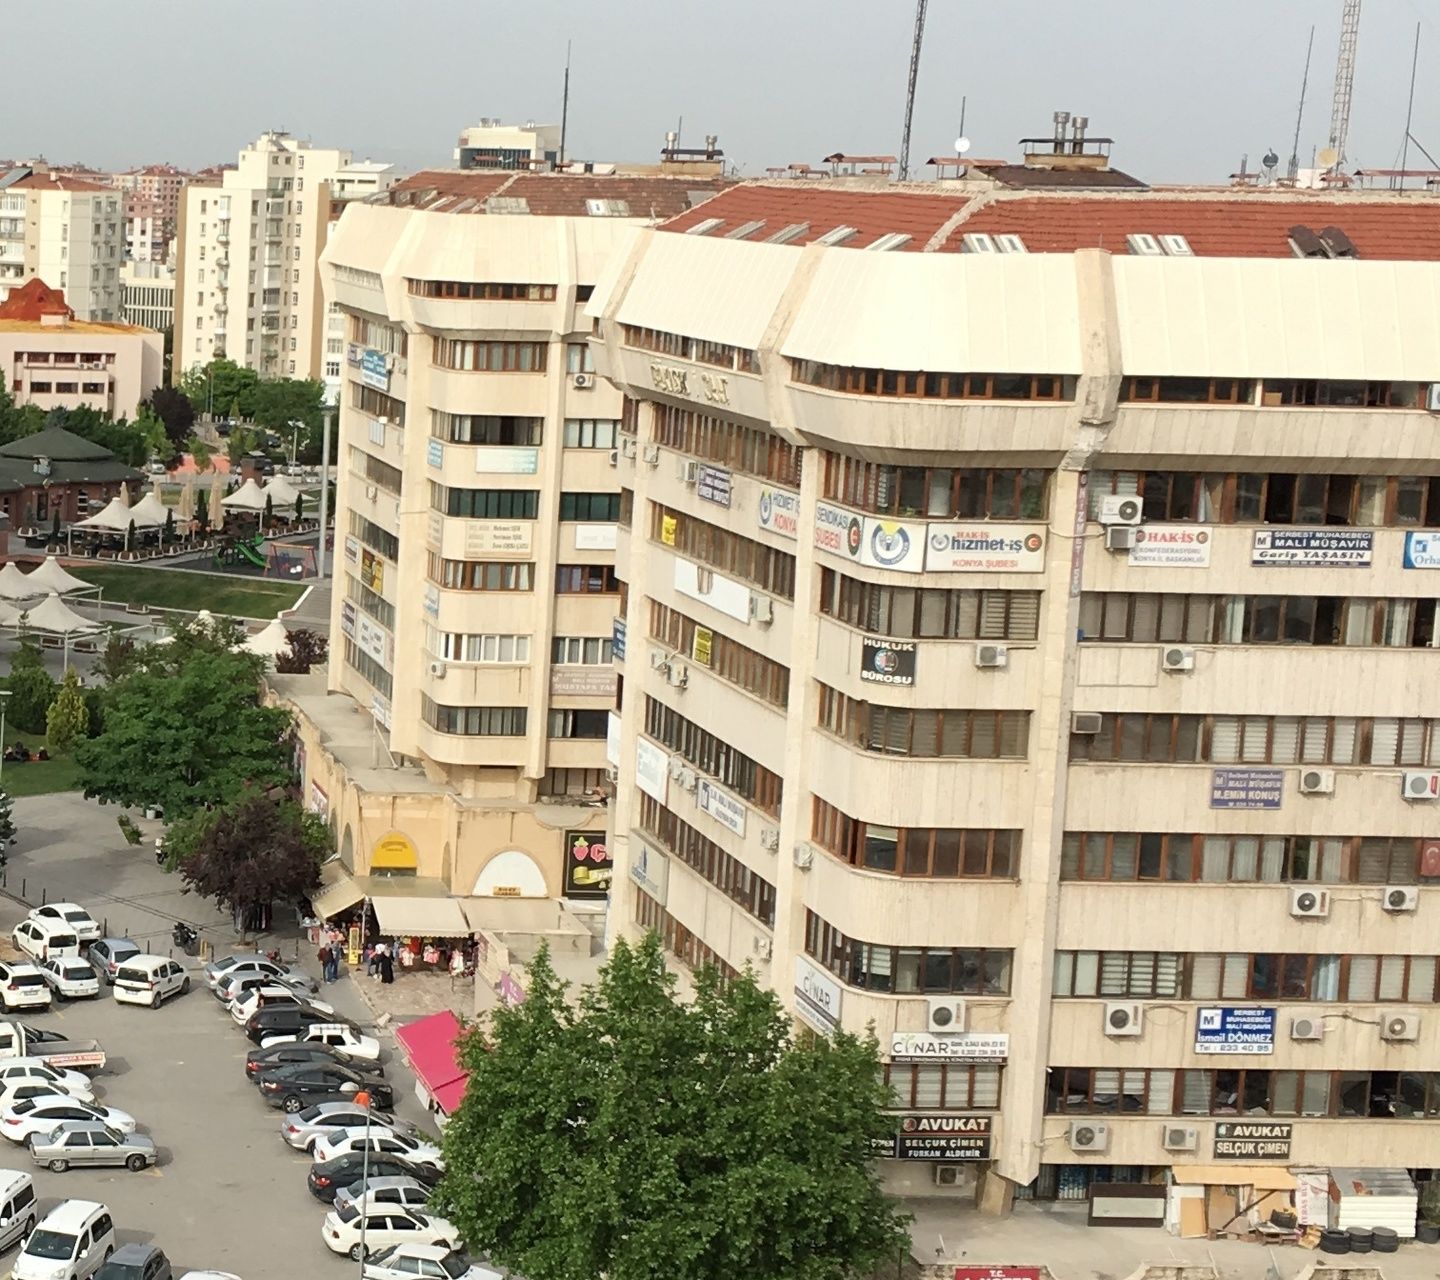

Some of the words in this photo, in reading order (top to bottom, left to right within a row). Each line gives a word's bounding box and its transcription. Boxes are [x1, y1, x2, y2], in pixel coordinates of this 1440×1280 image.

[951, 536, 1023, 554] hizmet-iş
[1274, 538, 1306, 548] MALİ
[1310, 538, 1369, 549] MÜŞAVİR
[1259, 551, 1298, 560] Garip
[1303, 551, 1365, 560] YAŞASIN
[952, 559, 983, 568] KONYA
[864, 638, 914, 651] HUKUK
[861, 670, 912, 684] BÜROSU
[1248, 790, 1280, 801] KONUŞ
[1228, 1031, 1272, 1043] DÖNMEZ
[917, 1119, 989, 1131] AVUKAT
[1233, 1125, 1290, 1137] AVUKAT
[905, 1139, 947, 1149] SELÇUK
[949, 1138, 984, 1148] ÇİMEN
[1216, 1142, 1256, 1157] SELÇUK
[1257, 1142, 1289, 1157] ÇİMEN
[908, 1149, 941, 1157] FURKAN
